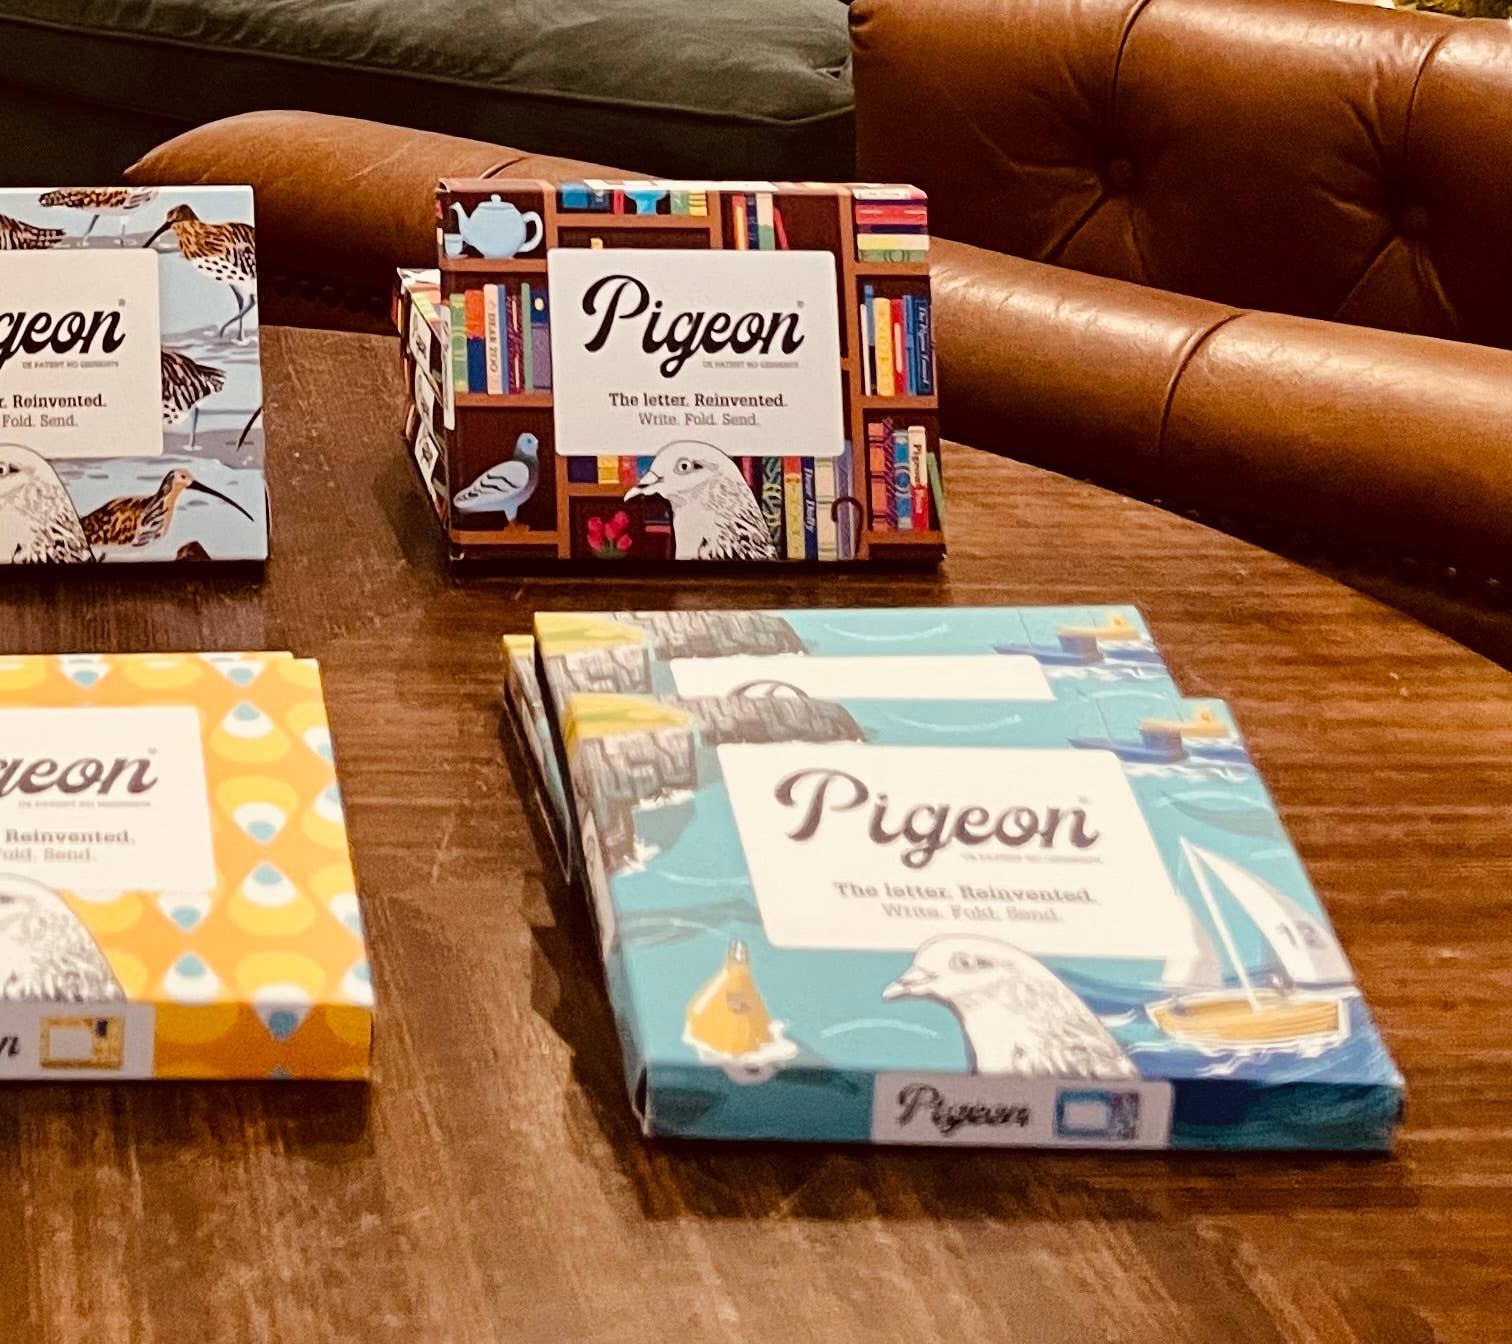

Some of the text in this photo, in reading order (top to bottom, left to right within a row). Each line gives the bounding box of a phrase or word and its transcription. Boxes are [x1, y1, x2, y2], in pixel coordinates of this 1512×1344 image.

[582, 274, 805, 379] Pigeon
[13, 393, 107, 408] Reinvented.
[609, 392, 788, 408] The letter. Reinvented.
[2, 415, 36, 428] Fold.
[40, 414, 79, 428] Send.
[638, 412, 760, 426] Write. Fold. Send.
[773, 767, 1101, 870] Pigeon
[5, 829, 136, 845] Reinvented.
[833, 881, 879, 898] The
[896, 1081, 1033, 1138] Pigeon
